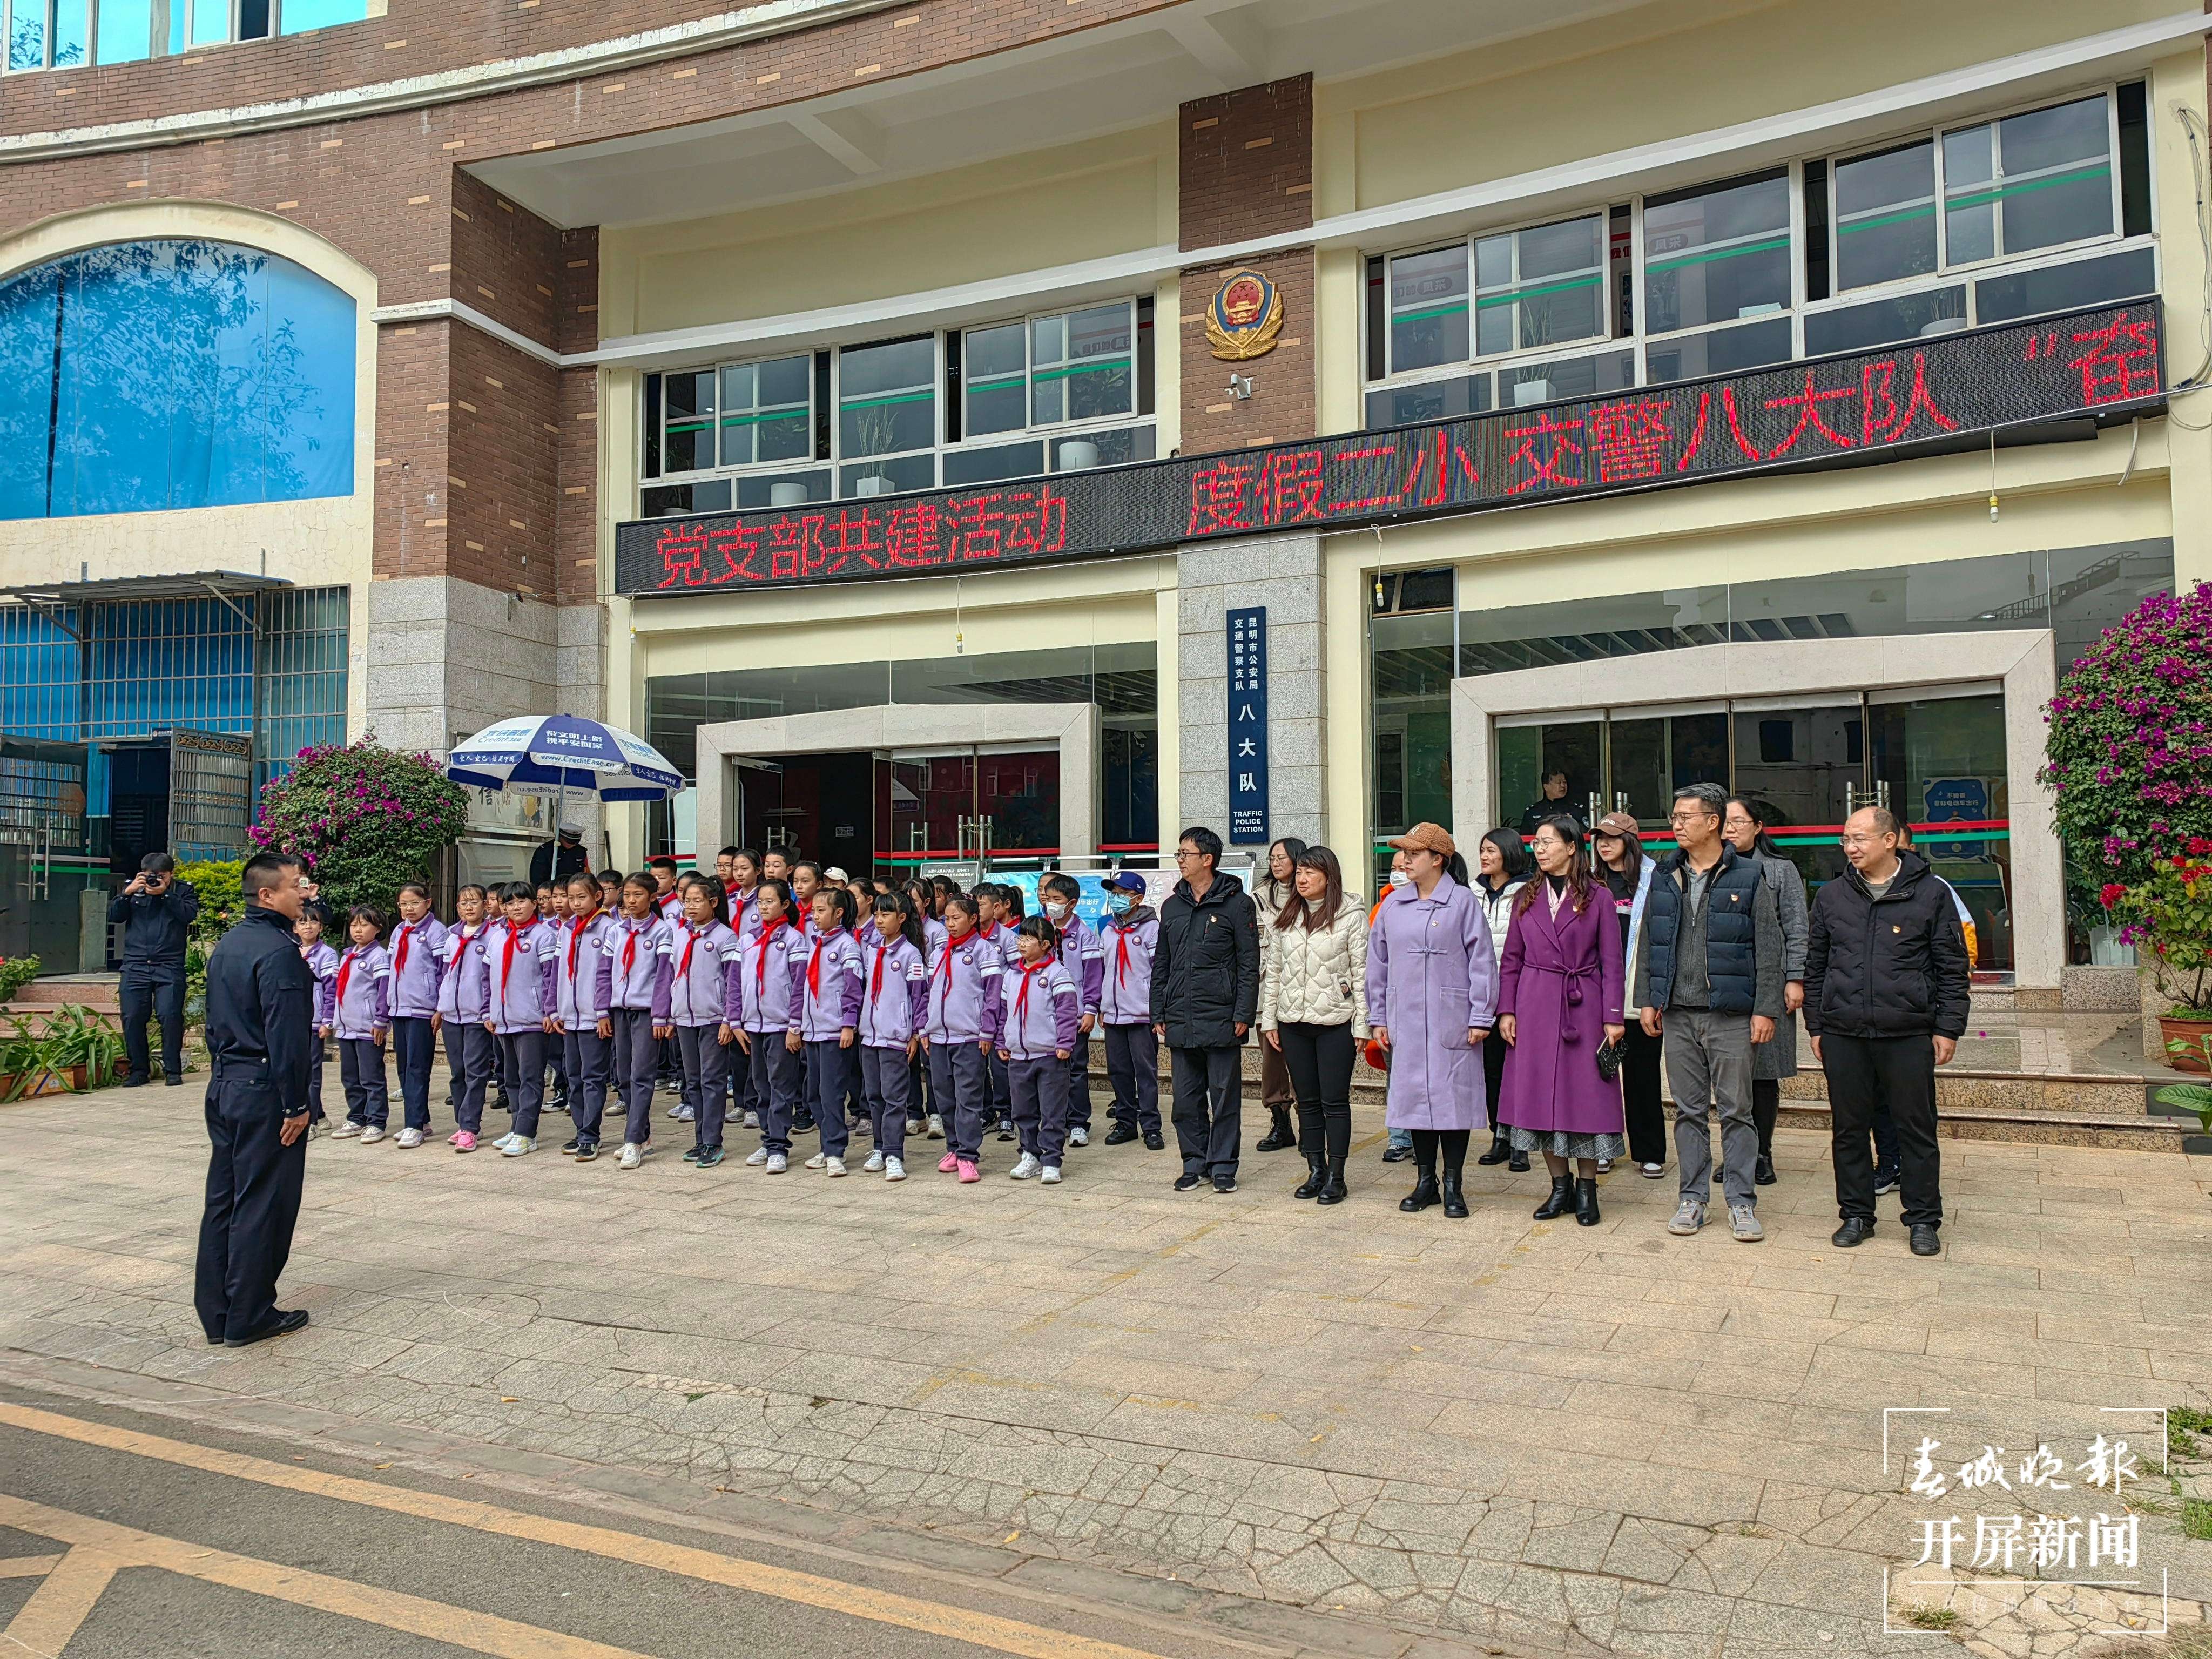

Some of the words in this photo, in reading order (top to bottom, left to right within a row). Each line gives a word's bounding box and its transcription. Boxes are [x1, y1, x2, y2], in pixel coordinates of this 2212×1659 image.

[657, 484, 1067, 588] 党支部共建活动
[1505, 351, 1958, 495] 交警八大队
[1234, 618, 1244, 691] 交通警察支队
[1248, 617, 1258, 690] 昆明市公安局
[545, 730, 603, 743] 带文明上路
[546, 737, 604, 750] 携平安回家
[1238, 704, 1257, 792] 八大队
[541, 754, 615, 768] www.CreditEase.cn
[478, 787, 493, 806] 信
